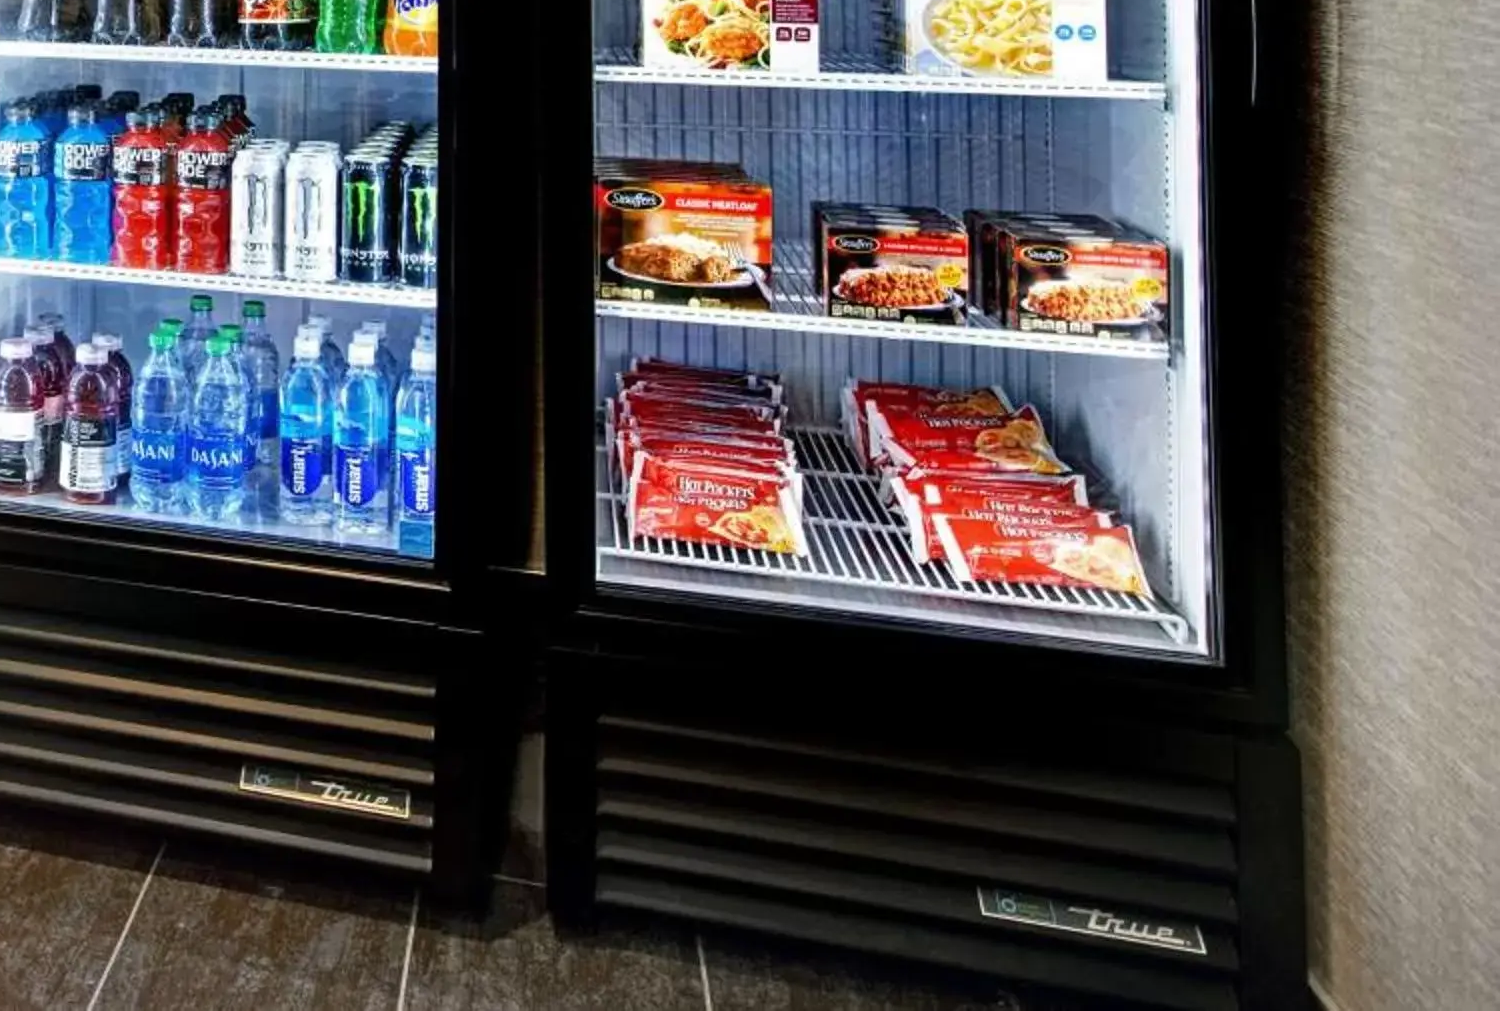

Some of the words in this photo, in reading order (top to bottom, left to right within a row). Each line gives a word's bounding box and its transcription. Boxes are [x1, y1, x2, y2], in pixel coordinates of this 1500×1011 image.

[131, 438, 176, 461] ASANI
[191, 446, 243, 470] DASANI
[346, 457, 362, 504] smart
[413, 465, 430, 512] smart
